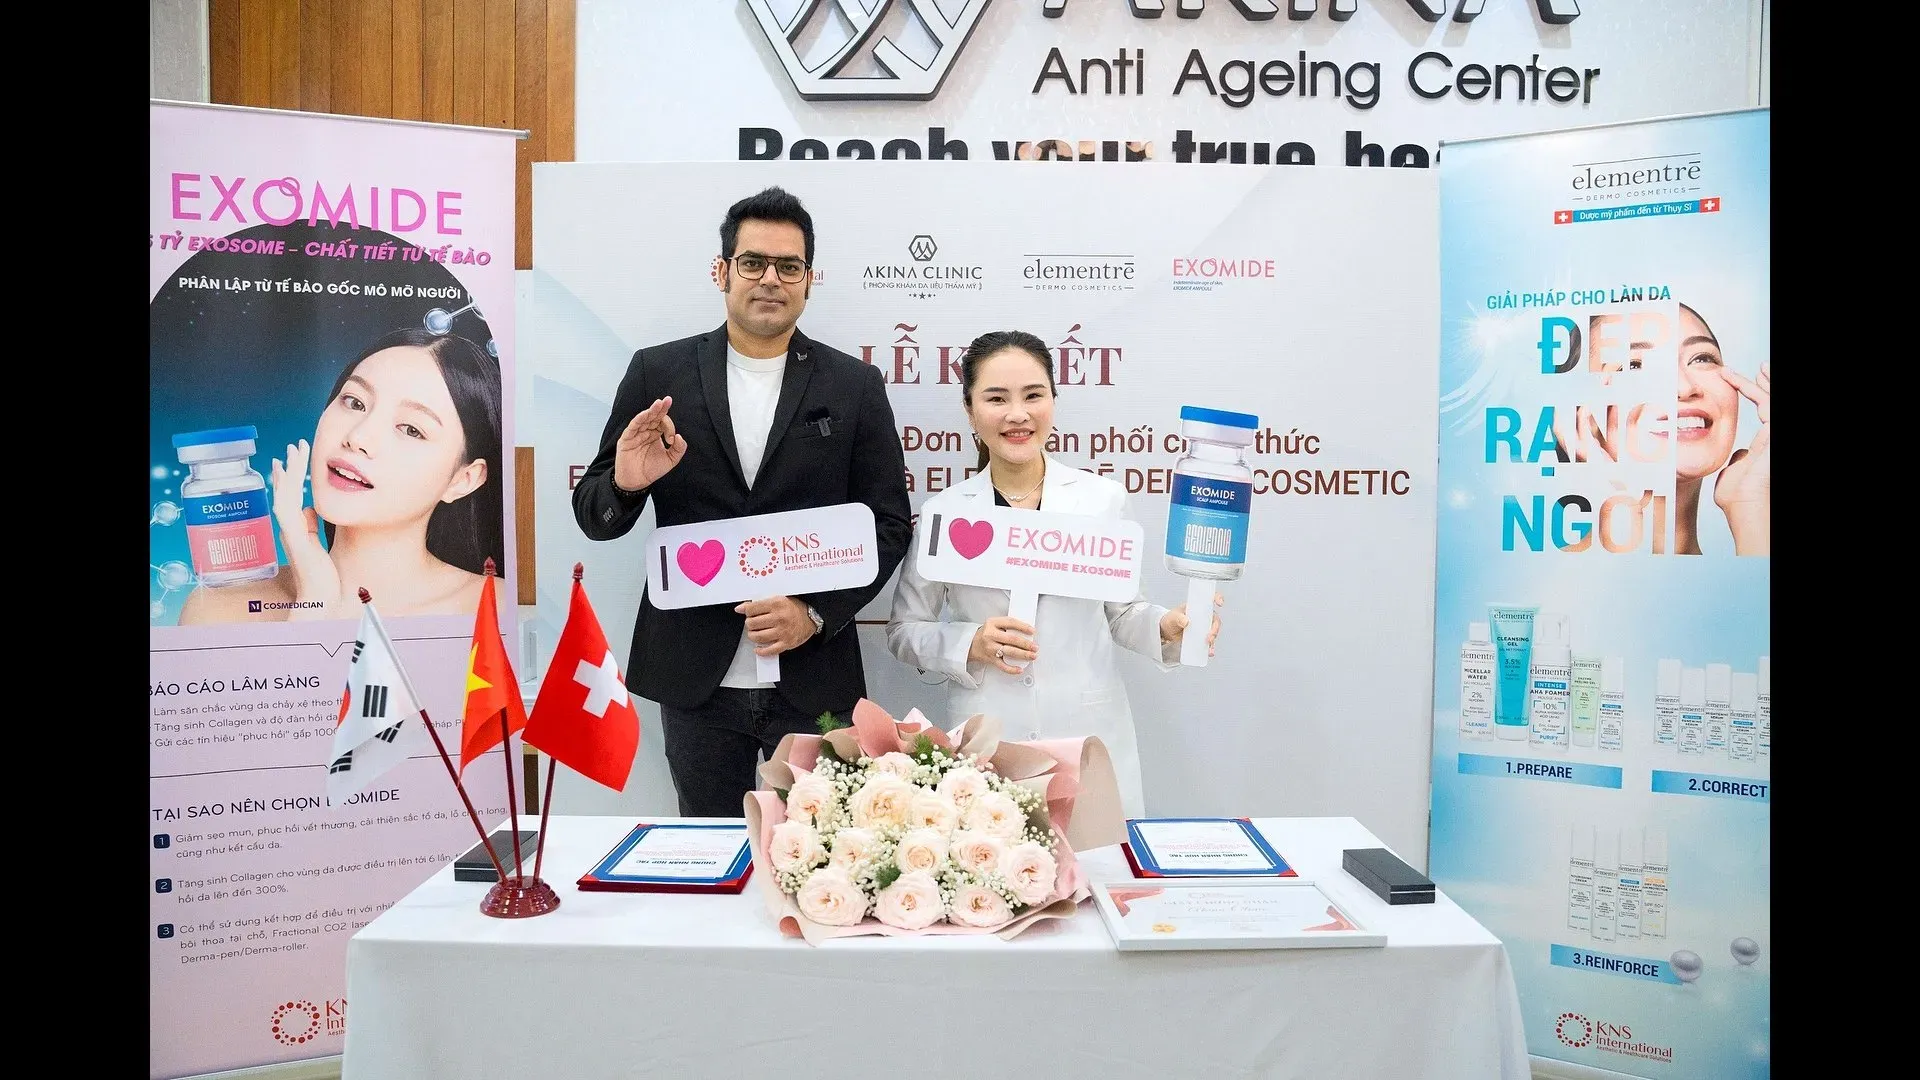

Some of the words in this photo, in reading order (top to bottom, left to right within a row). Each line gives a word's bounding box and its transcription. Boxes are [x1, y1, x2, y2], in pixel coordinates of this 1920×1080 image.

[1032, 47, 1144, 95] Anti
[1173, 49, 1381, 110] Ageing
[1408, 51, 1601, 104] Center
[1572, 161, 1701, 190] elementrē
[171, 172, 463, 236] EXOMIDE
[1586, 193, 1621, 201] DERMO
[1626, 187, 1687, 198] COSMETICS
[188, 235, 285, 256] EXOSOME
[304, 239, 359, 259] CHẤT
[363, 241, 397, 261] TIẾT
[401, 245, 426, 263] TỪ
[428, 244, 453, 264] TẾ
[453, 246, 491, 266] BÀO
[863, 265, 918, 278] AKINA
[922, 266, 983, 279] CLINIC
[1023, 258, 1135, 280] elementrē
[1172, 257, 1275, 278] EXOMIDE
[179, 275, 220, 291] PHÂN
[225, 276, 251, 294] LẬP
[254, 279, 276, 293] TỪ
[275, 277, 291, 293] TẾ
[294, 278, 323, 295] BÀO
[327, 278, 361, 296] GỐC
[364, 280, 387, 297] MÔ
[390, 279, 415, 298] MỠ
[417, 281, 461, 299] NGƯỜI
[1487, 290, 1518, 310] GIẢI
[1522, 287, 1567, 308] PHÁP
[1571, 289, 1606, 306] CHO
[1610, 285, 1643, 304] LÀN
[1648, 286, 1671, 301] DA
[901, 426, 962, 452] Đơn
[1090, 425, 1154, 459] phối
[1255, 427, 1320, 454] thức
[1484, 402, 1670, 477] RẠNG
[1190, 485, 1235, 500] EXOMIDE
[1252, 469, 1410, 496] COSMETIC
[202, 500, 250, 514] EXOMIDE
[782, 532, 820, 553] KNS
[1007, 526, 1134, 561] EXOMIDE
[783, 544, 864, 565] International
[813, 560, 840, 568] Healthcare
[1005, 556, 1069, 573] #EXOMIDE
[1072, 564, 1132, 579] EXOSOME
[263, 601, 324, 610] COSMEDICIAN
[186, 679, 225, 694] CÁO
[231, 676, 268, 692] LÂM
[274, 674, 320, 690] SÀNG
[153, 707, 177, 716] Làm
[229, 702, 254, 713] vùng
[257, 701, 270, 710] da
[312, 698, 333, 707] theo
[154, 721, 180, 733] Tăng
[184, 720, 206, 730] sinh
[208, 717, 254, 729] Collagen
[255, 715, 267, 725] và
[325, 713, 338, 721] da
[176, 736, 194, 747] các
[1505, 761, 1573, 779] 1.PREPARE
[1689, 778, 1768, 798] 2.CORRECT
[152, 808, 181, 823] TẠI
[187, 803, 225, 819] SAO
[231, 798, 266, 814] NÊN
[271, 796, 321, 812] CHỌN
[175, 833, 204, 844] Giảm
[205, 846, 226, 856] như
[267, 841, 283, 850] da.
[177, 879, 204, 890] Tăng
[206, 876, 228, 886] sinh
[230, 872, 274, 884] Collagen
[276, 869, 294, 878] cho
[322, 865, 335, 875] da
[398, 857, 413, 866] lên
[428, 855, 435, 863] 6
[197, 894, 211, 903] da
[255, 885, 289, 896] 300%.
[179, 924, 195, 935] Có
[201, 936, 225, 947] thoa
[272, 925, 320, 939] Fractional
[324, 922, 347, 933] CO2
[1573, 953, 1659, 977] 3.REINFORCE
[1596, 1020, 1632, 1040] KNS
[1596, 1034, 1672, 1058] International
